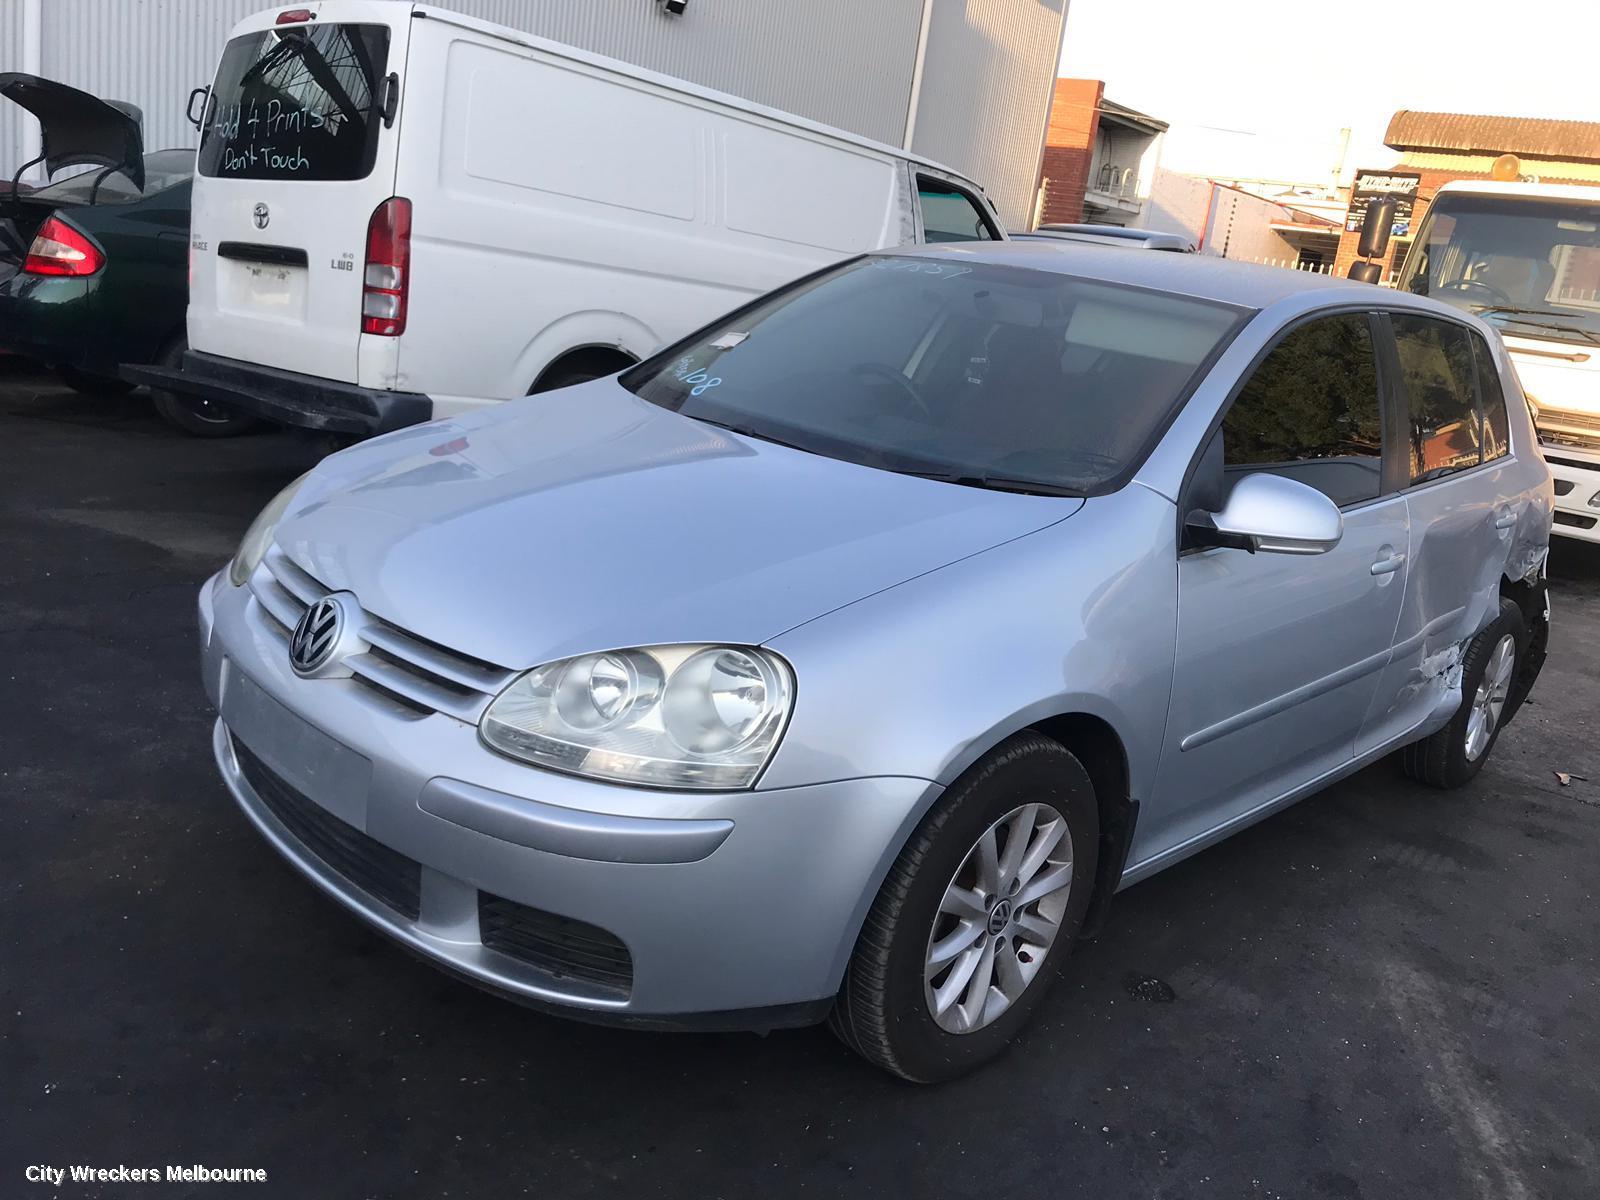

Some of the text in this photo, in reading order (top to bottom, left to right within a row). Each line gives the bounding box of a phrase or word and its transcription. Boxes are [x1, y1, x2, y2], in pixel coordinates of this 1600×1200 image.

[247, 97, 260, 139] 4
[261, 146, 310, 170] Touch
[330, 259, 354, 271] LWB
